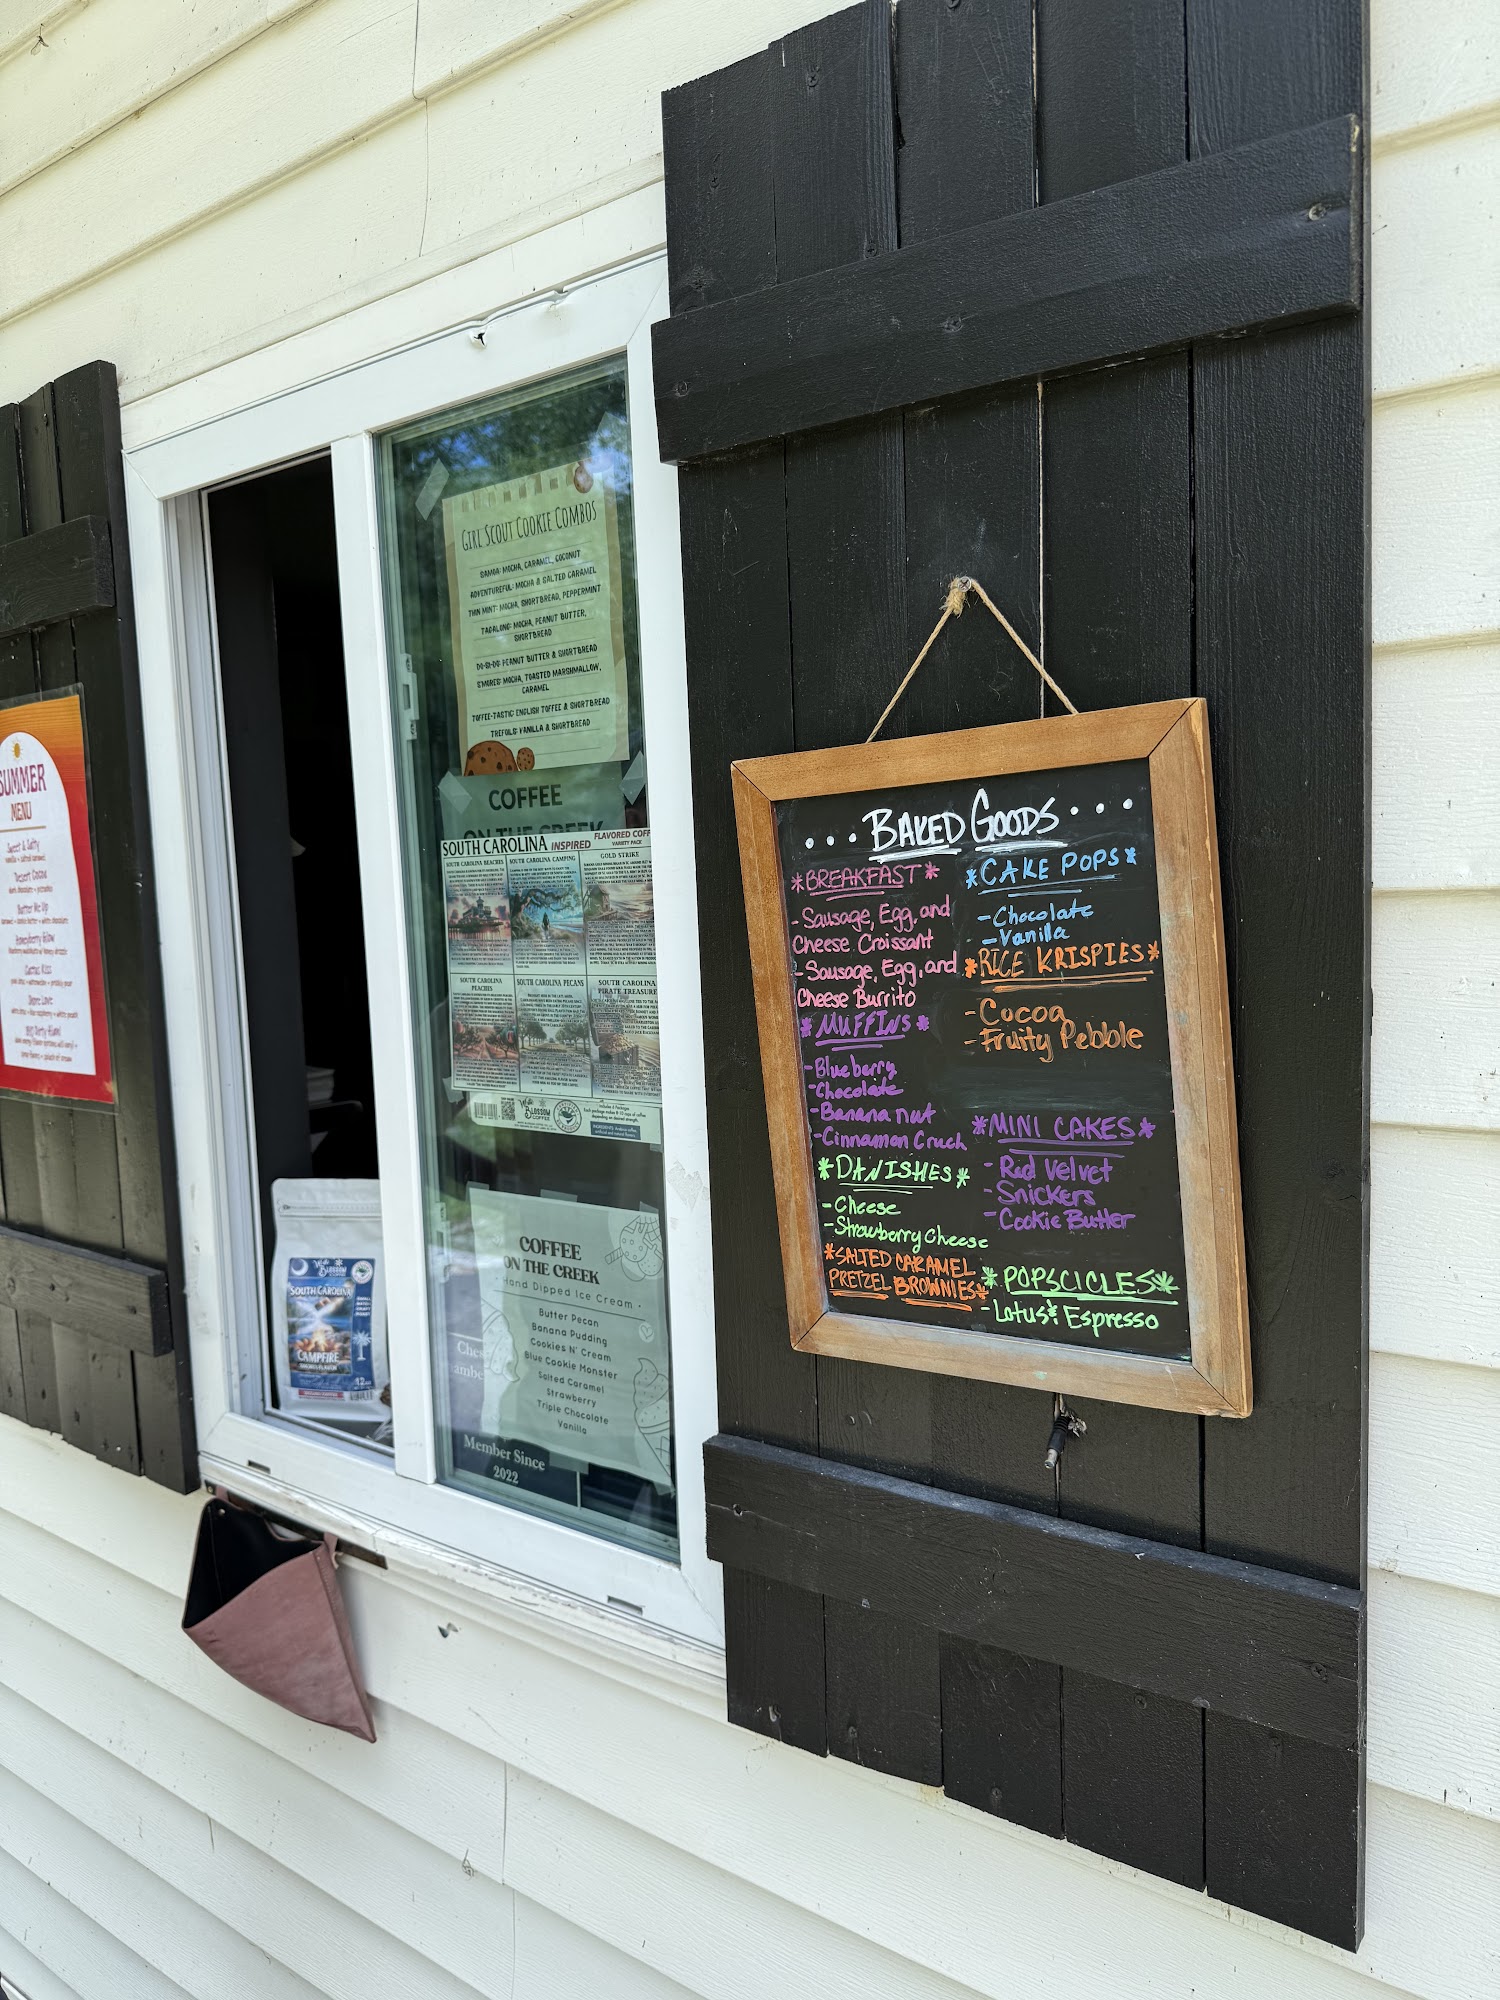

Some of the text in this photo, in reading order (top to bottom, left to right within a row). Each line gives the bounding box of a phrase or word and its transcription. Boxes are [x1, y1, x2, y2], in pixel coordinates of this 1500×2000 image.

[461, 500, 597, 551] GIRL SCOUT COOKIE COMBOS
[502, 563, 524, 575] MOCHA,
[524, 556, 554, 569] CARAMEL,
[555, 549, 581, 563] COCONUT
[515, 578, 535, 591] MOCHA
[542, 572, 566, 584] SALTED
[567, 566, 597, 579] CARAMEL
[468, 584, 601, 618] THIN MINT: MOCHA, SHORTBREAD, PEPPERMINT
[513, 618, 534, 631] MOCHA,
[535, 613, 559, 626] PEANUT
[560, 609, 587, 621] BUTTER,
[514, 629, 552, 642] SHORTBREAD
[502, 656, 525, 667] PEANUT
[526, 651, 550, 663] BUTTER
[551, 651, 556, 659] &
[558, 643, 598, 658] SHORTBREAD
[502, 674, 523, 686] MOCHA,
[525, 671, 551, 682] TOASTED
[521, 683, 550, 695] CARAMEL
[516, 707, 540, 718] ENGLISH
[541, 703, 562, 715] TOFFEE
[569, 697, 611, 710] SHORTBREAD
[518, 723, 544, 735] VANILLA
[551, 718, 591, 731] SHORTBREAD
[489, 784, 563, 811] COFFEE
[11, 801, 32, 821] MENU
[862, 788, 1060, 852] BAKED GOODS
[442, 838, 480, 857] SOUTH
[483, 835, 548, 855] CAROLINA
[551, 839, 591, 851] INSPIRED
[594, 829, 631, 840] FLAVORED
[446, 860, 461, 868] SOUTH
[552, 855, 576, 863] CAMPING
[980, 847, 1120, 887] CAKE POPS
[805, 864, 922, 891] BREAKFAST
[879, 903, 918, 933] Egg,
[919, 894, 950, 919] and
[792, 928, 934, 955] Cheese Croissant
[925, 950, 957, 974] and
[978, 942, 1145, 978] RICE KRISPIES
[517, 978, 585, 987] SOUTH CAROLINA PECANS
[598, 979, 656, 987] SOUTH CAROLINA
[623, 988, 658, 996] TREASURE
[797, 986, 917, 1009] Cheese Burrito
[815, 1010, 912, 1039] MUFFINS
[1060, 1018, 1144, 1050] Pebble
[896, 1102, 936, 1124] nut
[988, 1112, 1136, 1141] MINI CAKES
[835, 1153, 951, 1183] DANISHES
[1044, 1155, 1113, 1185] Velvet
[1063, 1208, 1136, 1231] Butter
[519, 1236, 582, 1261] COFFEE
[924, 1225, 989, 1249] Cheese
[503, 1255, 600, 1285] ON THE CREEK
[834, 1246, 977, 1279] SALTED CARAMEL
[290, 1286, 316, 1296] SOUTH
[828, 1268, 976, 1301] PRETZEL BROWNIES
[1002, 1265, 1157, 1296] POPSCICLES
[504, 1277, 633, 1310] Hand Dipped Ice Cream
[539, 1308, 599, 1328] Butter Pecan
[1063, 1304, 1160, 1338] Espresso
[531, 1322, 608, 1348] Banana Pudding
[297, 1349, 339, 1364] CAMPFIRE
[530, 1337, 567, 1352] Cookies
[581, 1348, 612, 1362] Cream
[524, 1350, 618, 1380] Blue Cookie Monster
[538, 1371, 604, 1394] Salted Caramel
[546, 1388, 597, 1408] Strawberry
[537, 1399, 609, 1425] Triple Chocolate
[557, 1419, 587, 1435] Vanilla
[463, 1433, 546, 1471] Member Since
[493, 1464, 519, 1485] 2022
